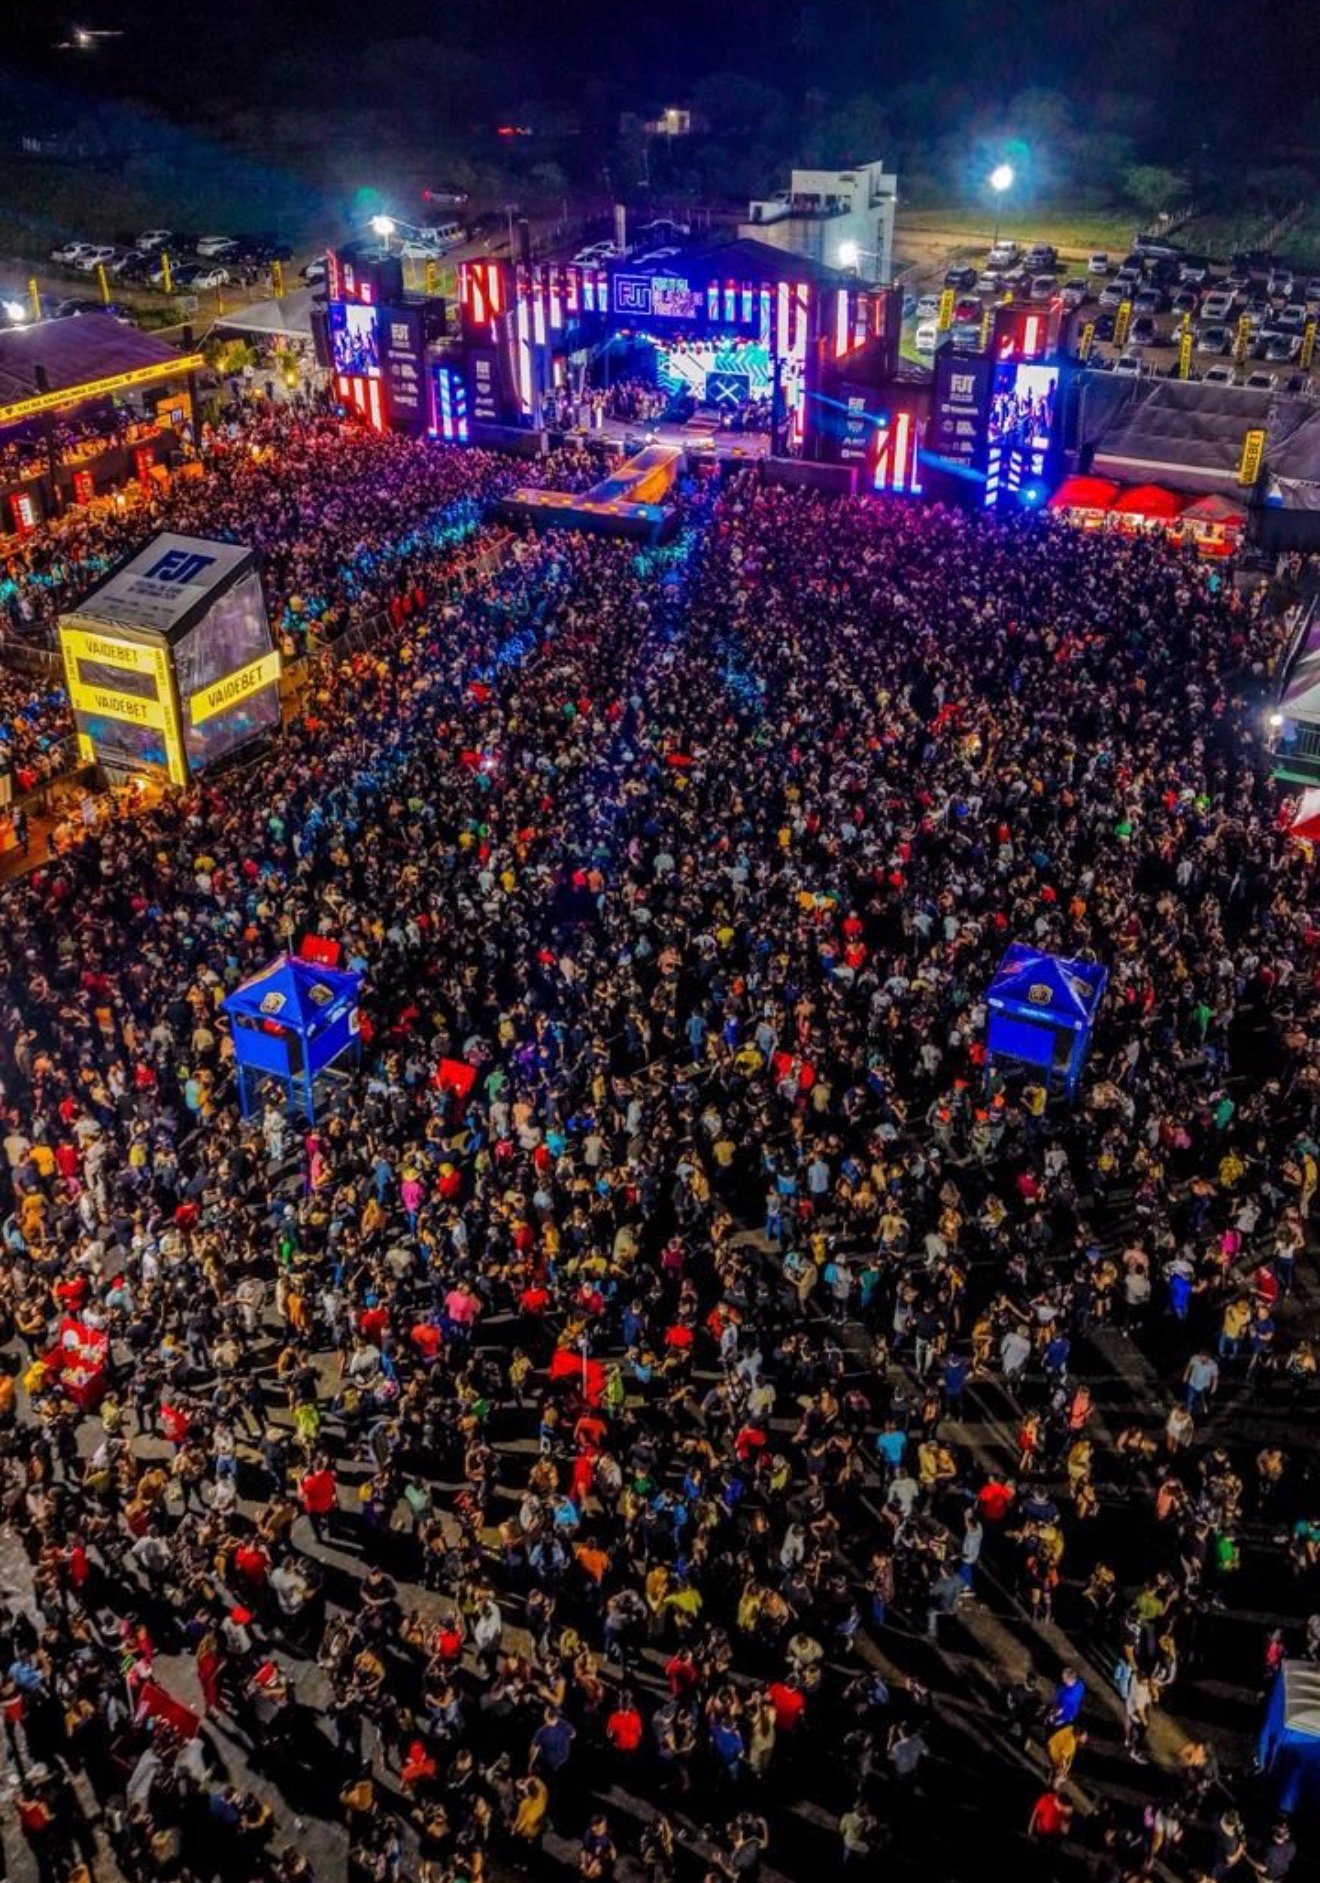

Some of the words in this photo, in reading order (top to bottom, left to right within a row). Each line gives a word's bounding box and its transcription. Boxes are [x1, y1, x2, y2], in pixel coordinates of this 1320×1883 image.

[618, 281, 651, 308] FJT
[951, 374, 976, 394] FJT
[143, 550, 218, 584] FJT
[86, 639, 138, 662] VAIDEBET
[208, 665, 263, 707] VAIDEBET
[95, 694, 147, 718] VAIDEBET
